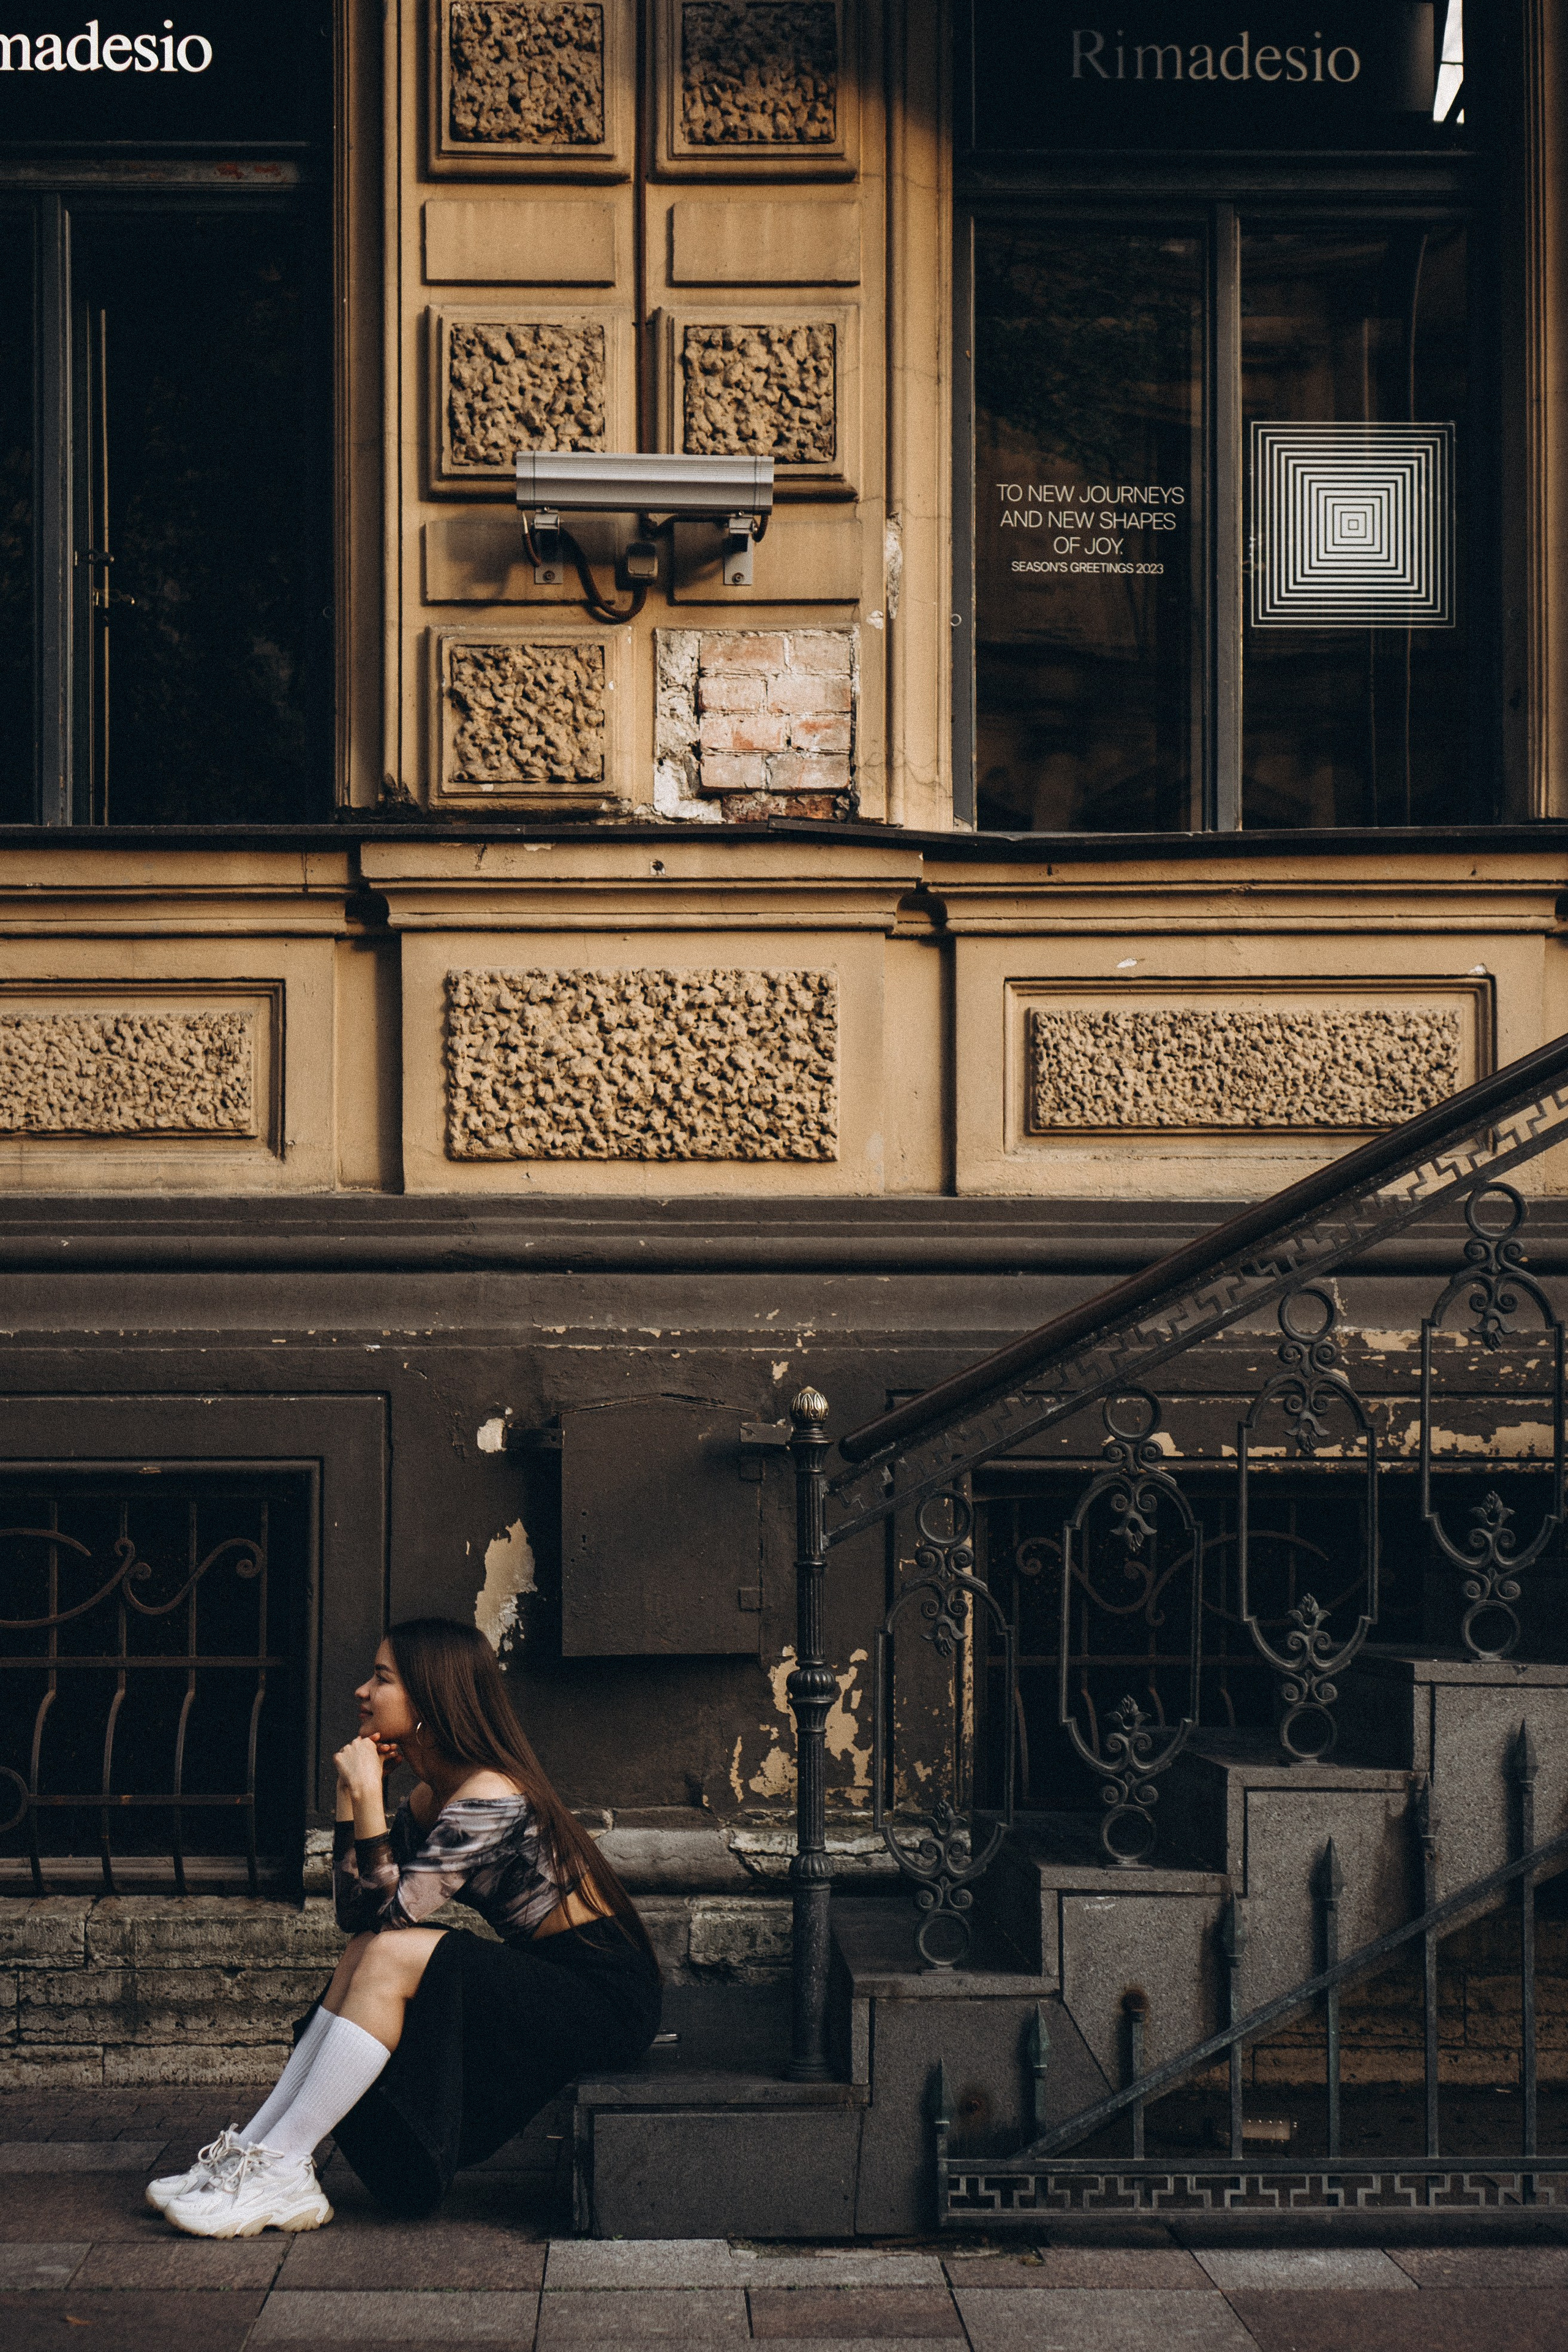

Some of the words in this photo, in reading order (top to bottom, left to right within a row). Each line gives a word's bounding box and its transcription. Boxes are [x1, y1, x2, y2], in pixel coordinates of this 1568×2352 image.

[1072, 29, 1360, 82] Rimadesio
[997, 484, 1022, 502] TO
[1028, 484, 1074, 502] NEW
[1079, 486, 1185, 504] JOURNEYS
[1000, 510, 1043, 528] AND
[1048, 511, 1094, 529] NEW
[1099, 511, 1176, 530] SHAPES
[1054, 536, 1080, 554] OF
[1085, 537, 1123, 555] JOY.
[1011, 561, 1068, 573] SEASON'S
[1070, 562, 1134, 573] GREETINGS
[1136, 563, 1164, 574] 2023
